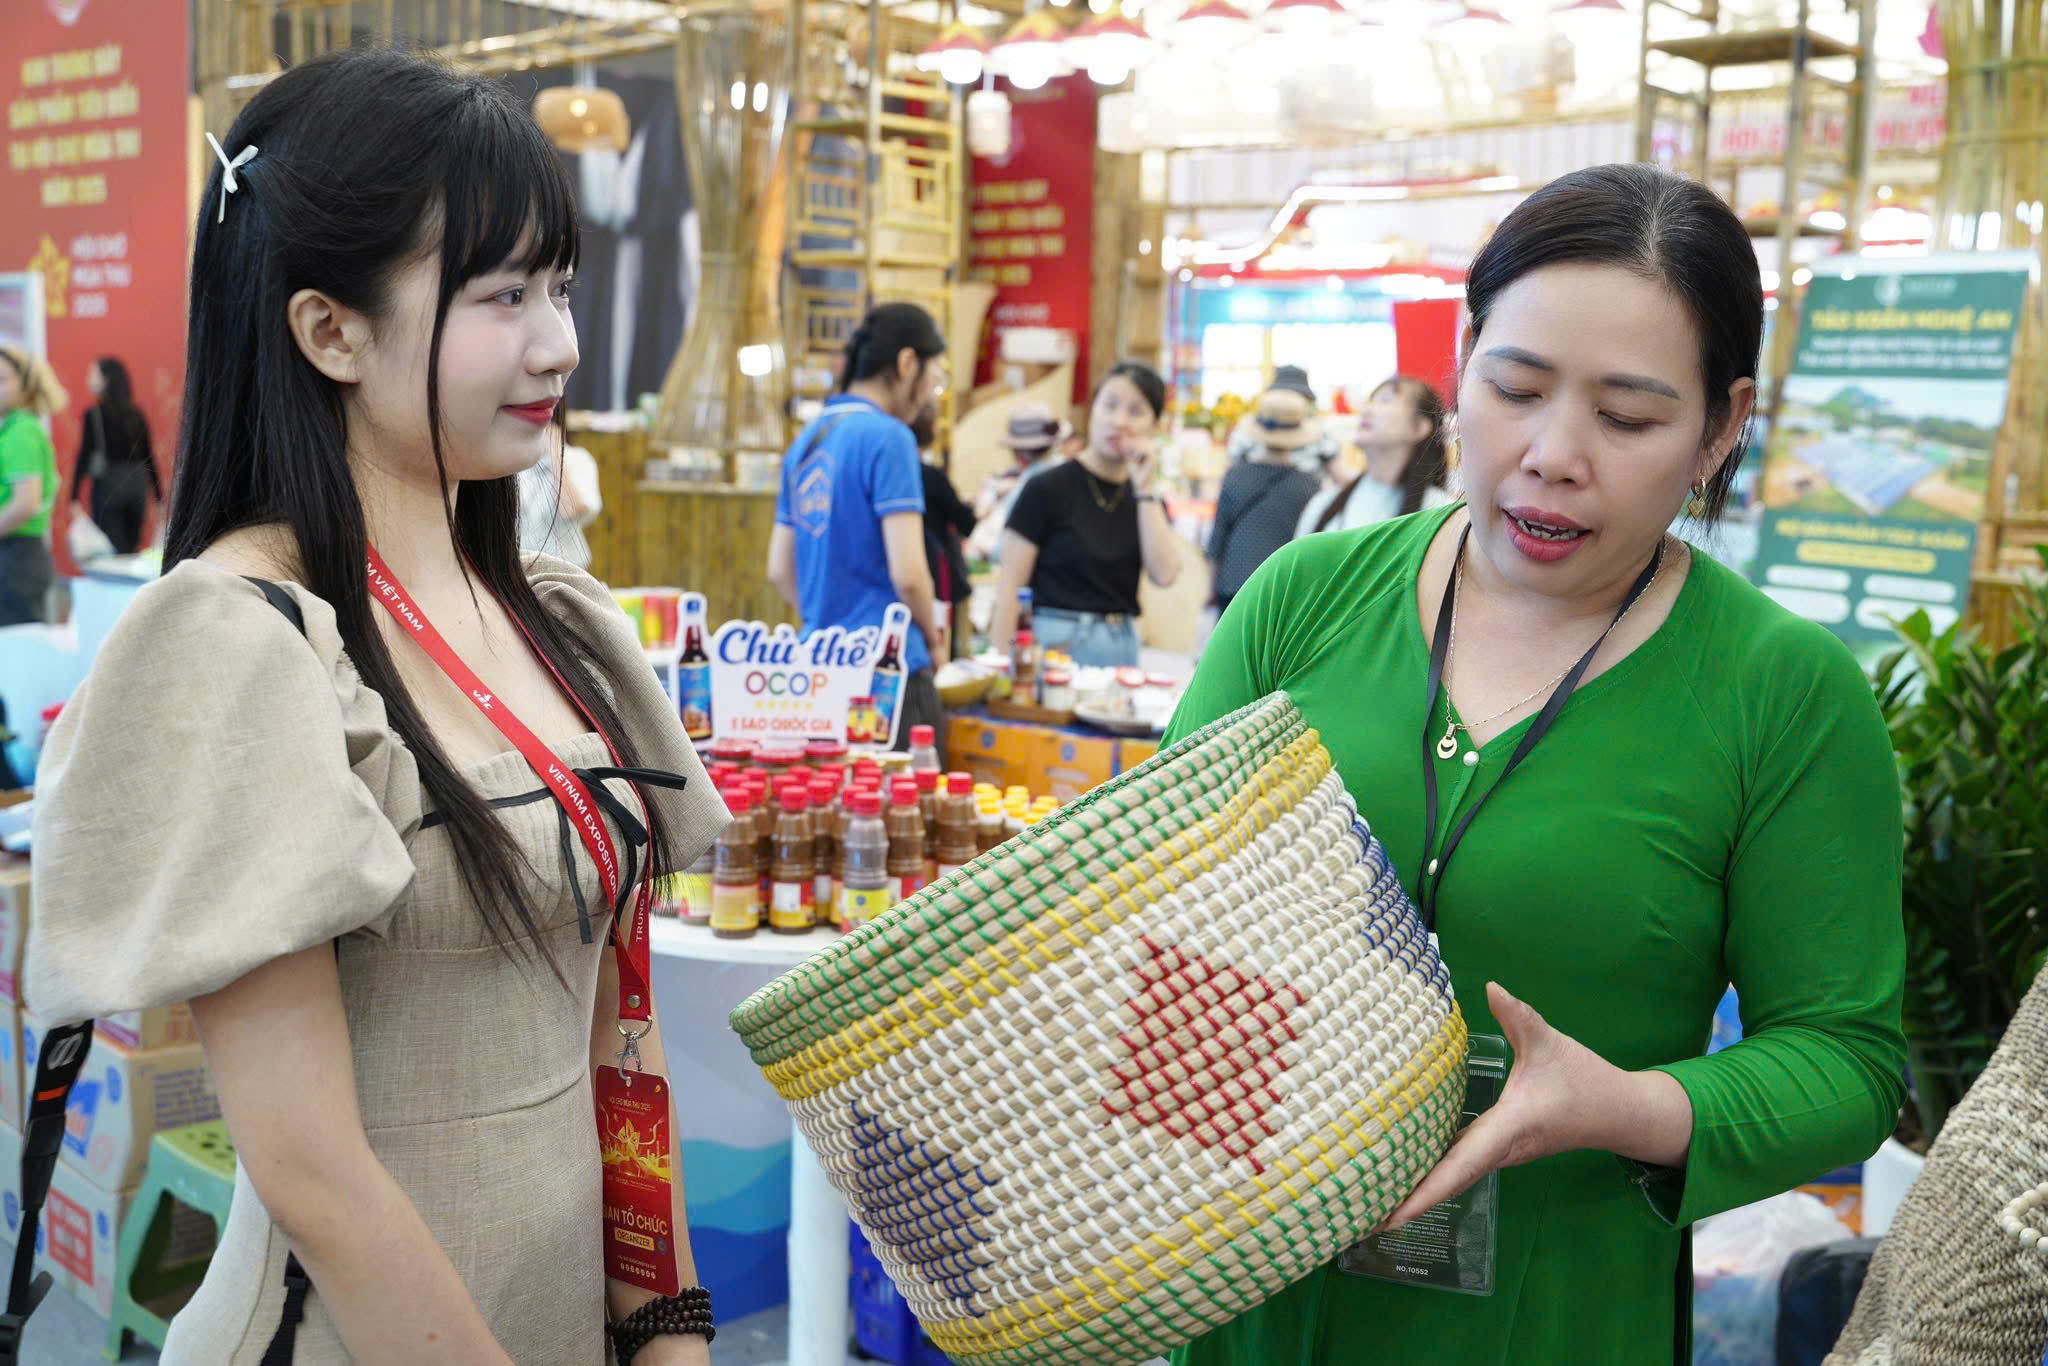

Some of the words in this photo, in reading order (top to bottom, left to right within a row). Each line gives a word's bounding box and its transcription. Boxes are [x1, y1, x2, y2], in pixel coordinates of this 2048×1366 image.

[375, 575, 401, 601] VIỆT
[397, 602, 425, 631] NAM
[718, 627, 795, 667] Chủ
[745, 670, 829, 697] OCOP
[548, 763, 588, 815] VIETNAM
[584, 813, 617, 896] EXPOSITION
[635, 900, 646, 943] TRUNG
[621, 1205, 635, 1226] TỔ
[636, 1213, 668, 1235] CHỨC
[616, 1230, 651, 1247] ORGANIZER
[1396, 1265, 1429, 1276] NO.10552
